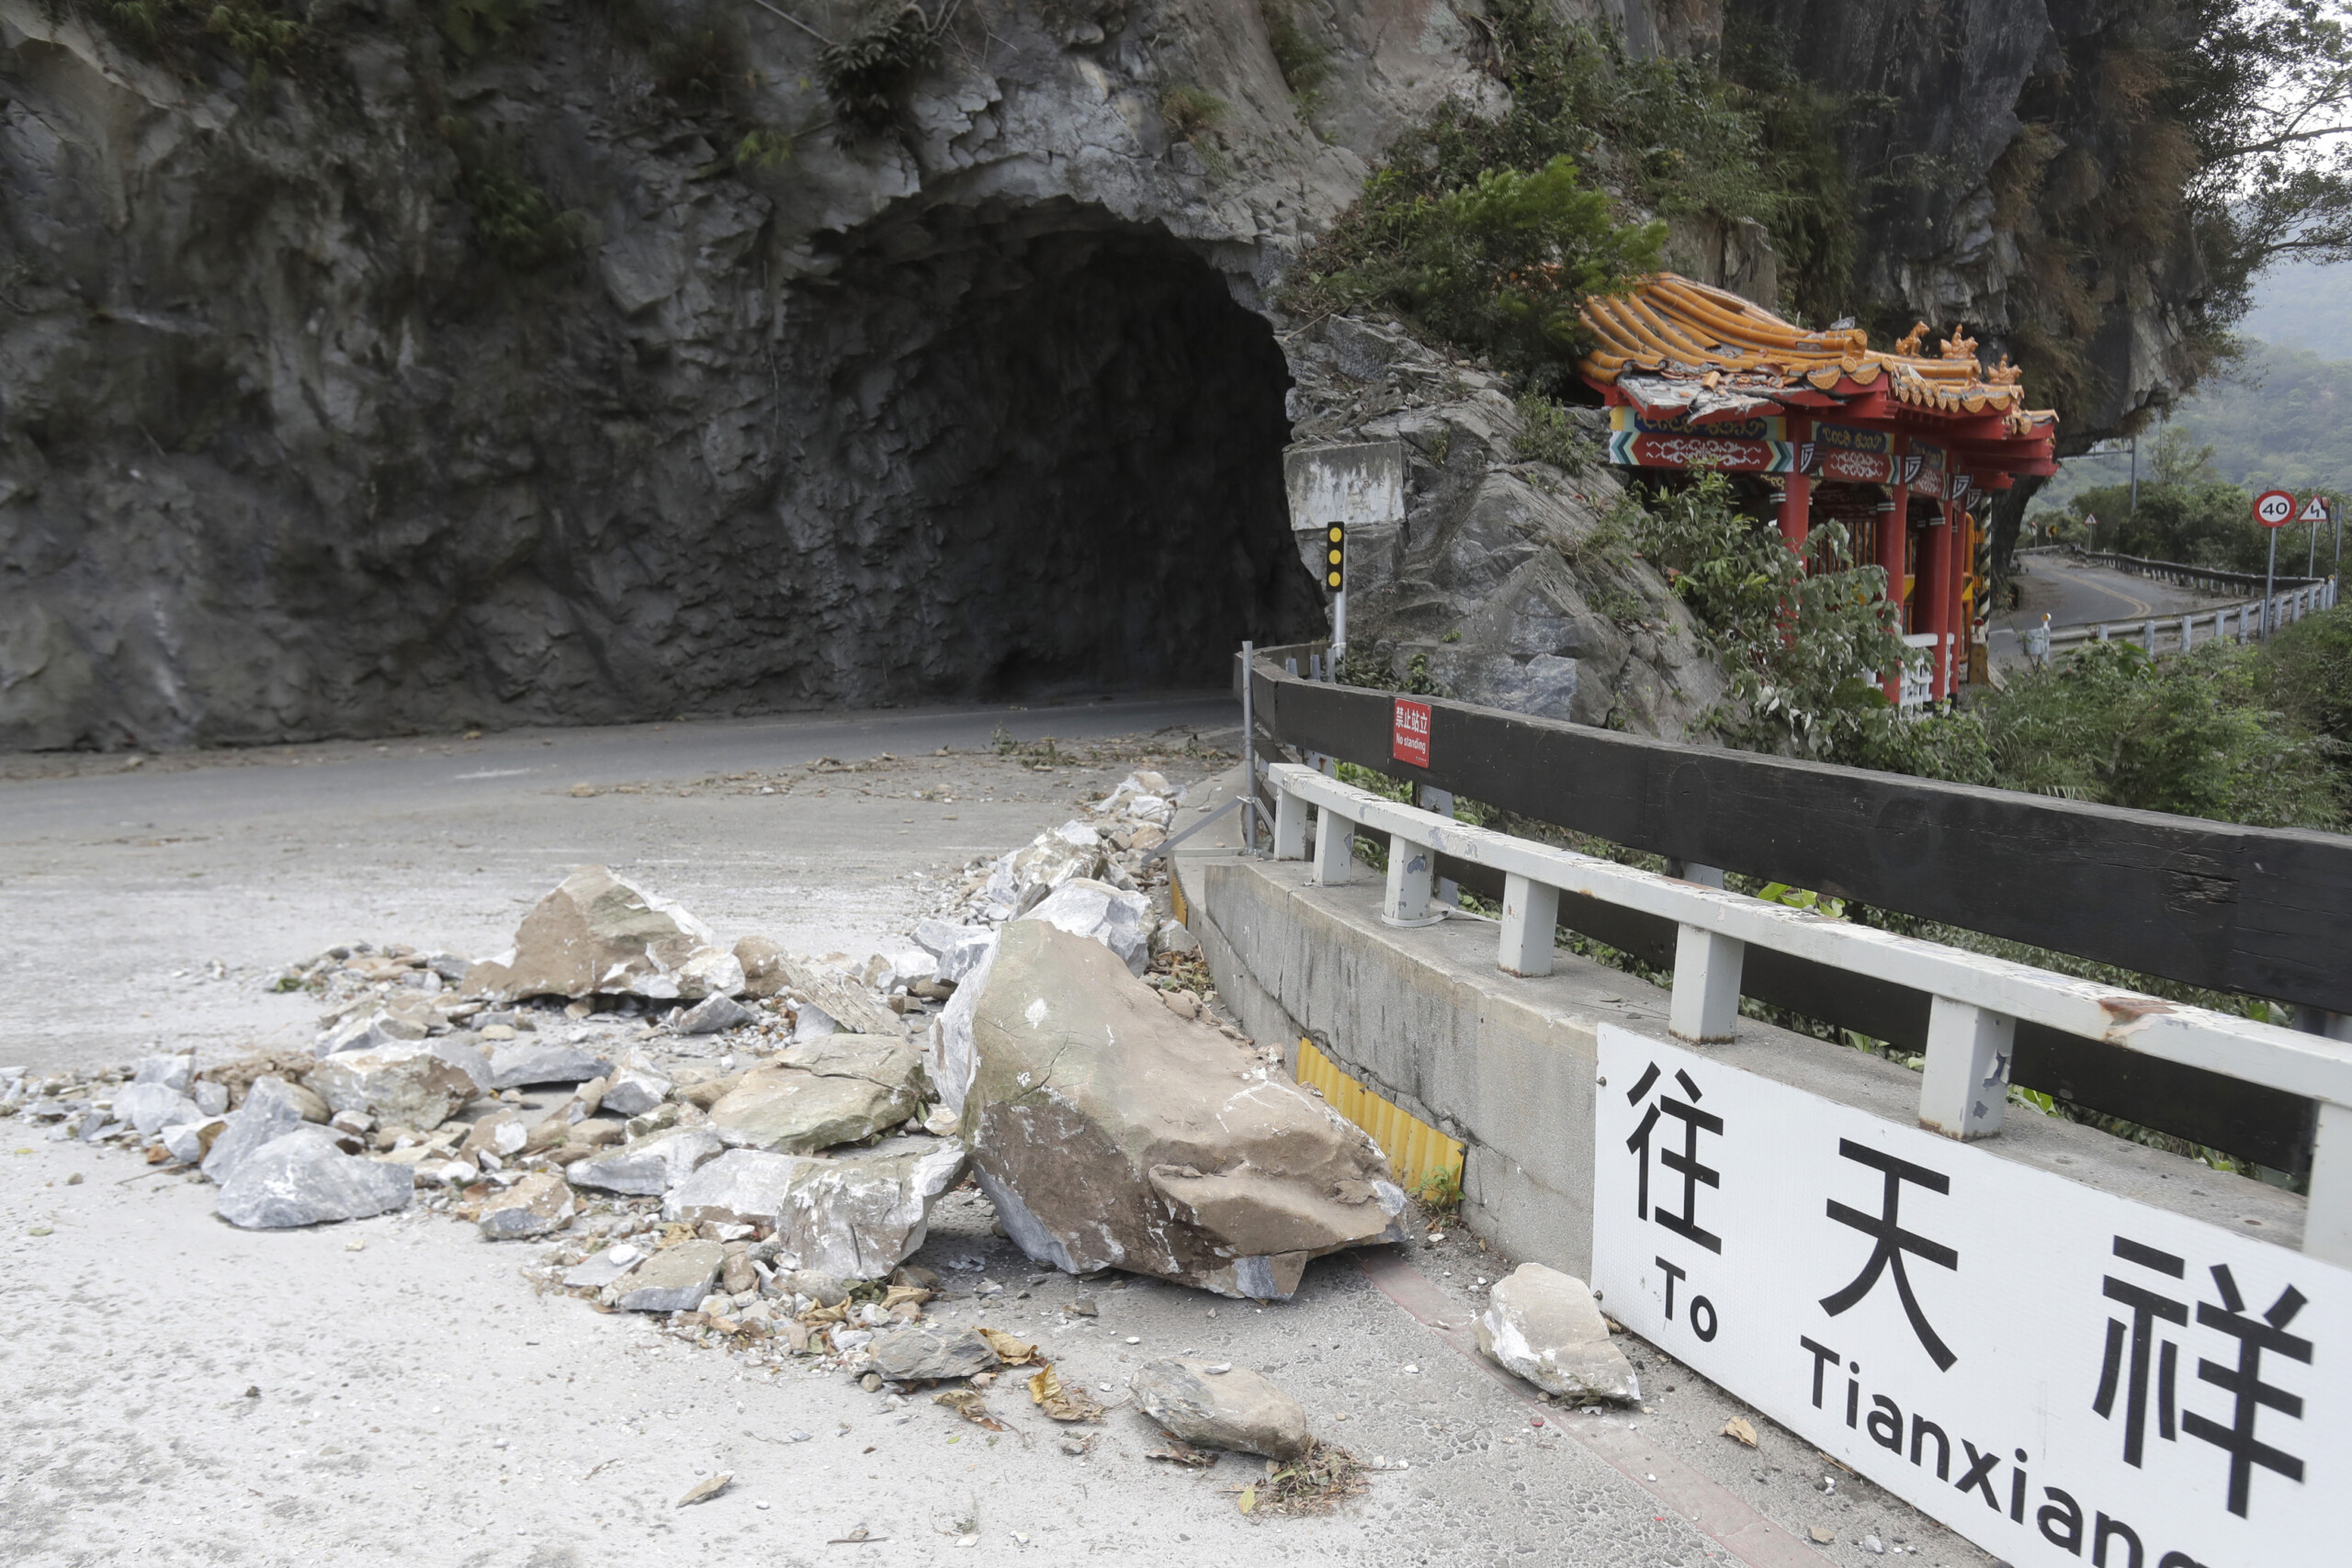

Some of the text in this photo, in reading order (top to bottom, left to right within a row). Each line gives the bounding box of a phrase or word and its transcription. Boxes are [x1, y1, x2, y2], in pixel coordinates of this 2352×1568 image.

[2262, 502, 2288, 514] 40
[1396, 706, 1428, 734] 禁止站立
[1396, 733, 1426, 754] No standing
[1656, 1255, 2211, 1568] To Tianxian
